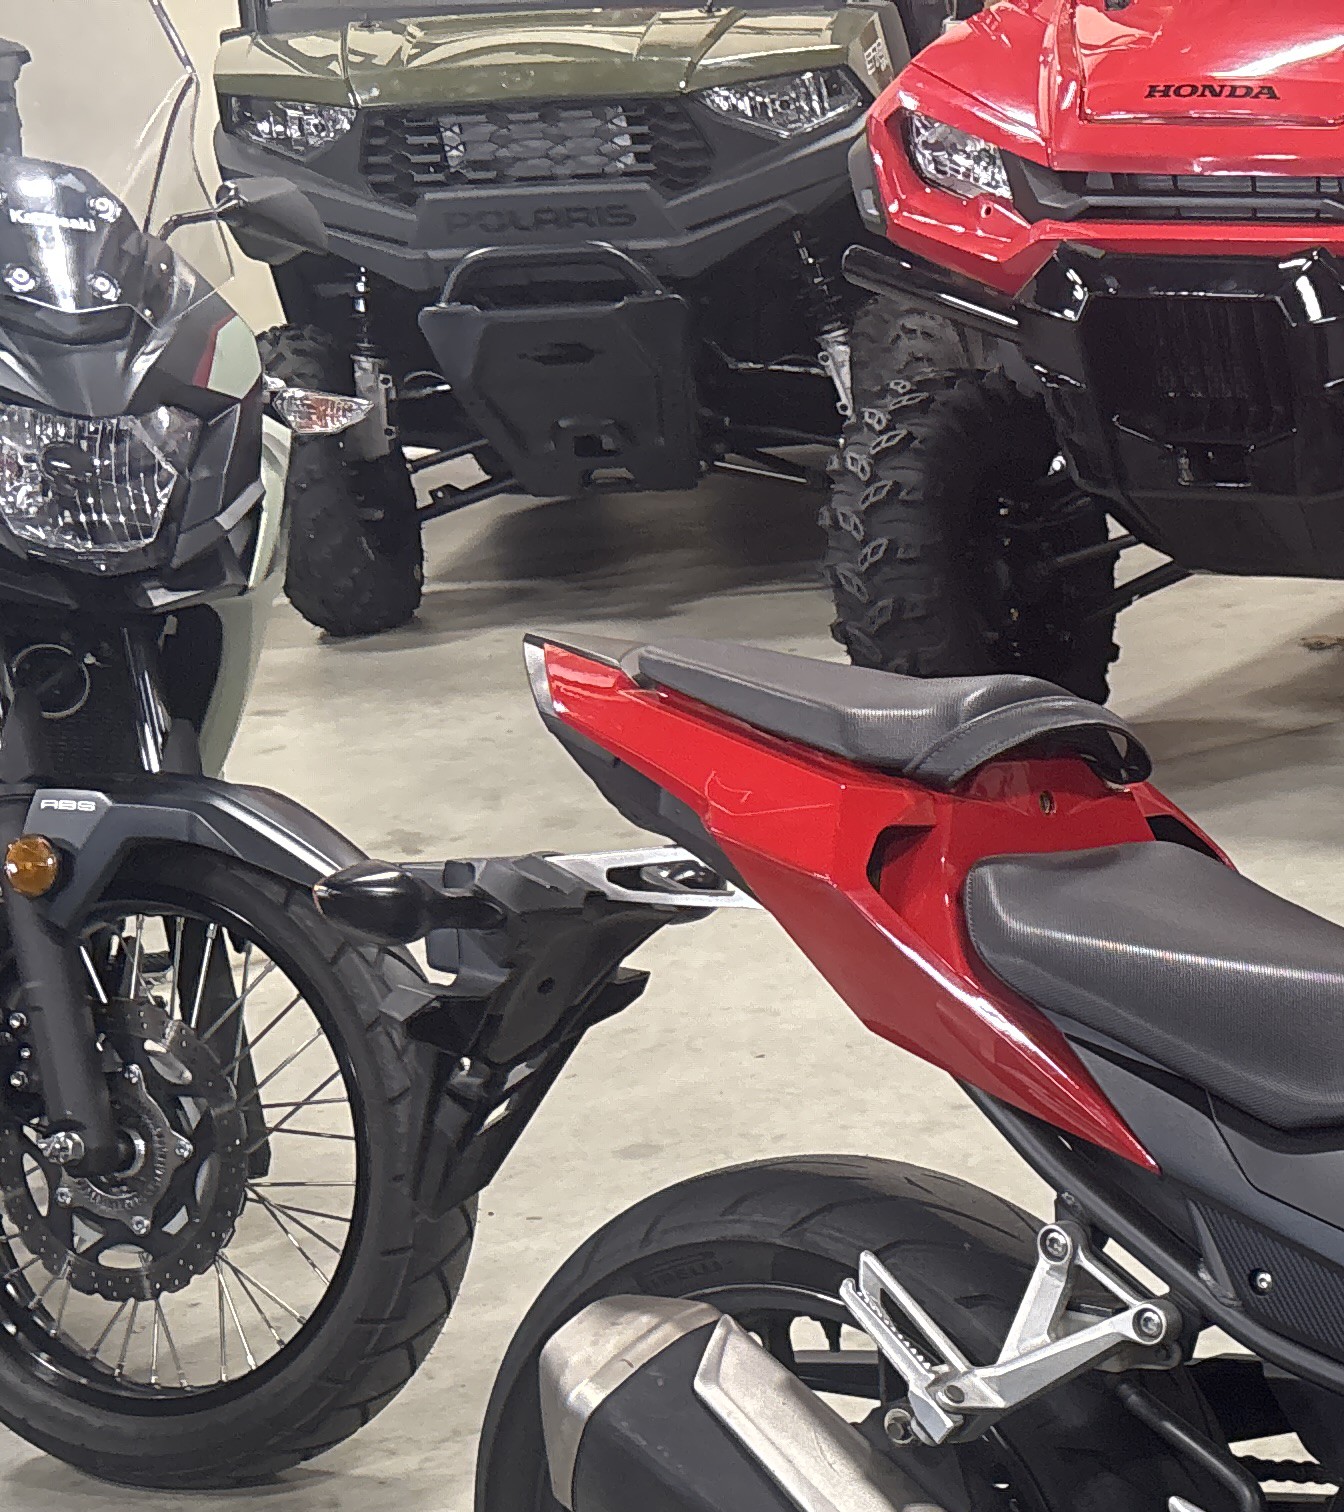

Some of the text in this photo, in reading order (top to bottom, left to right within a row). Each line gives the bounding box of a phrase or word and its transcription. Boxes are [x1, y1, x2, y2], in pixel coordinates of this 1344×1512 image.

[1144, 83, 1281, 101] HONDA
[443, 203, 637, 233] POLARIS
[41, 799, 96, 812] ABS
